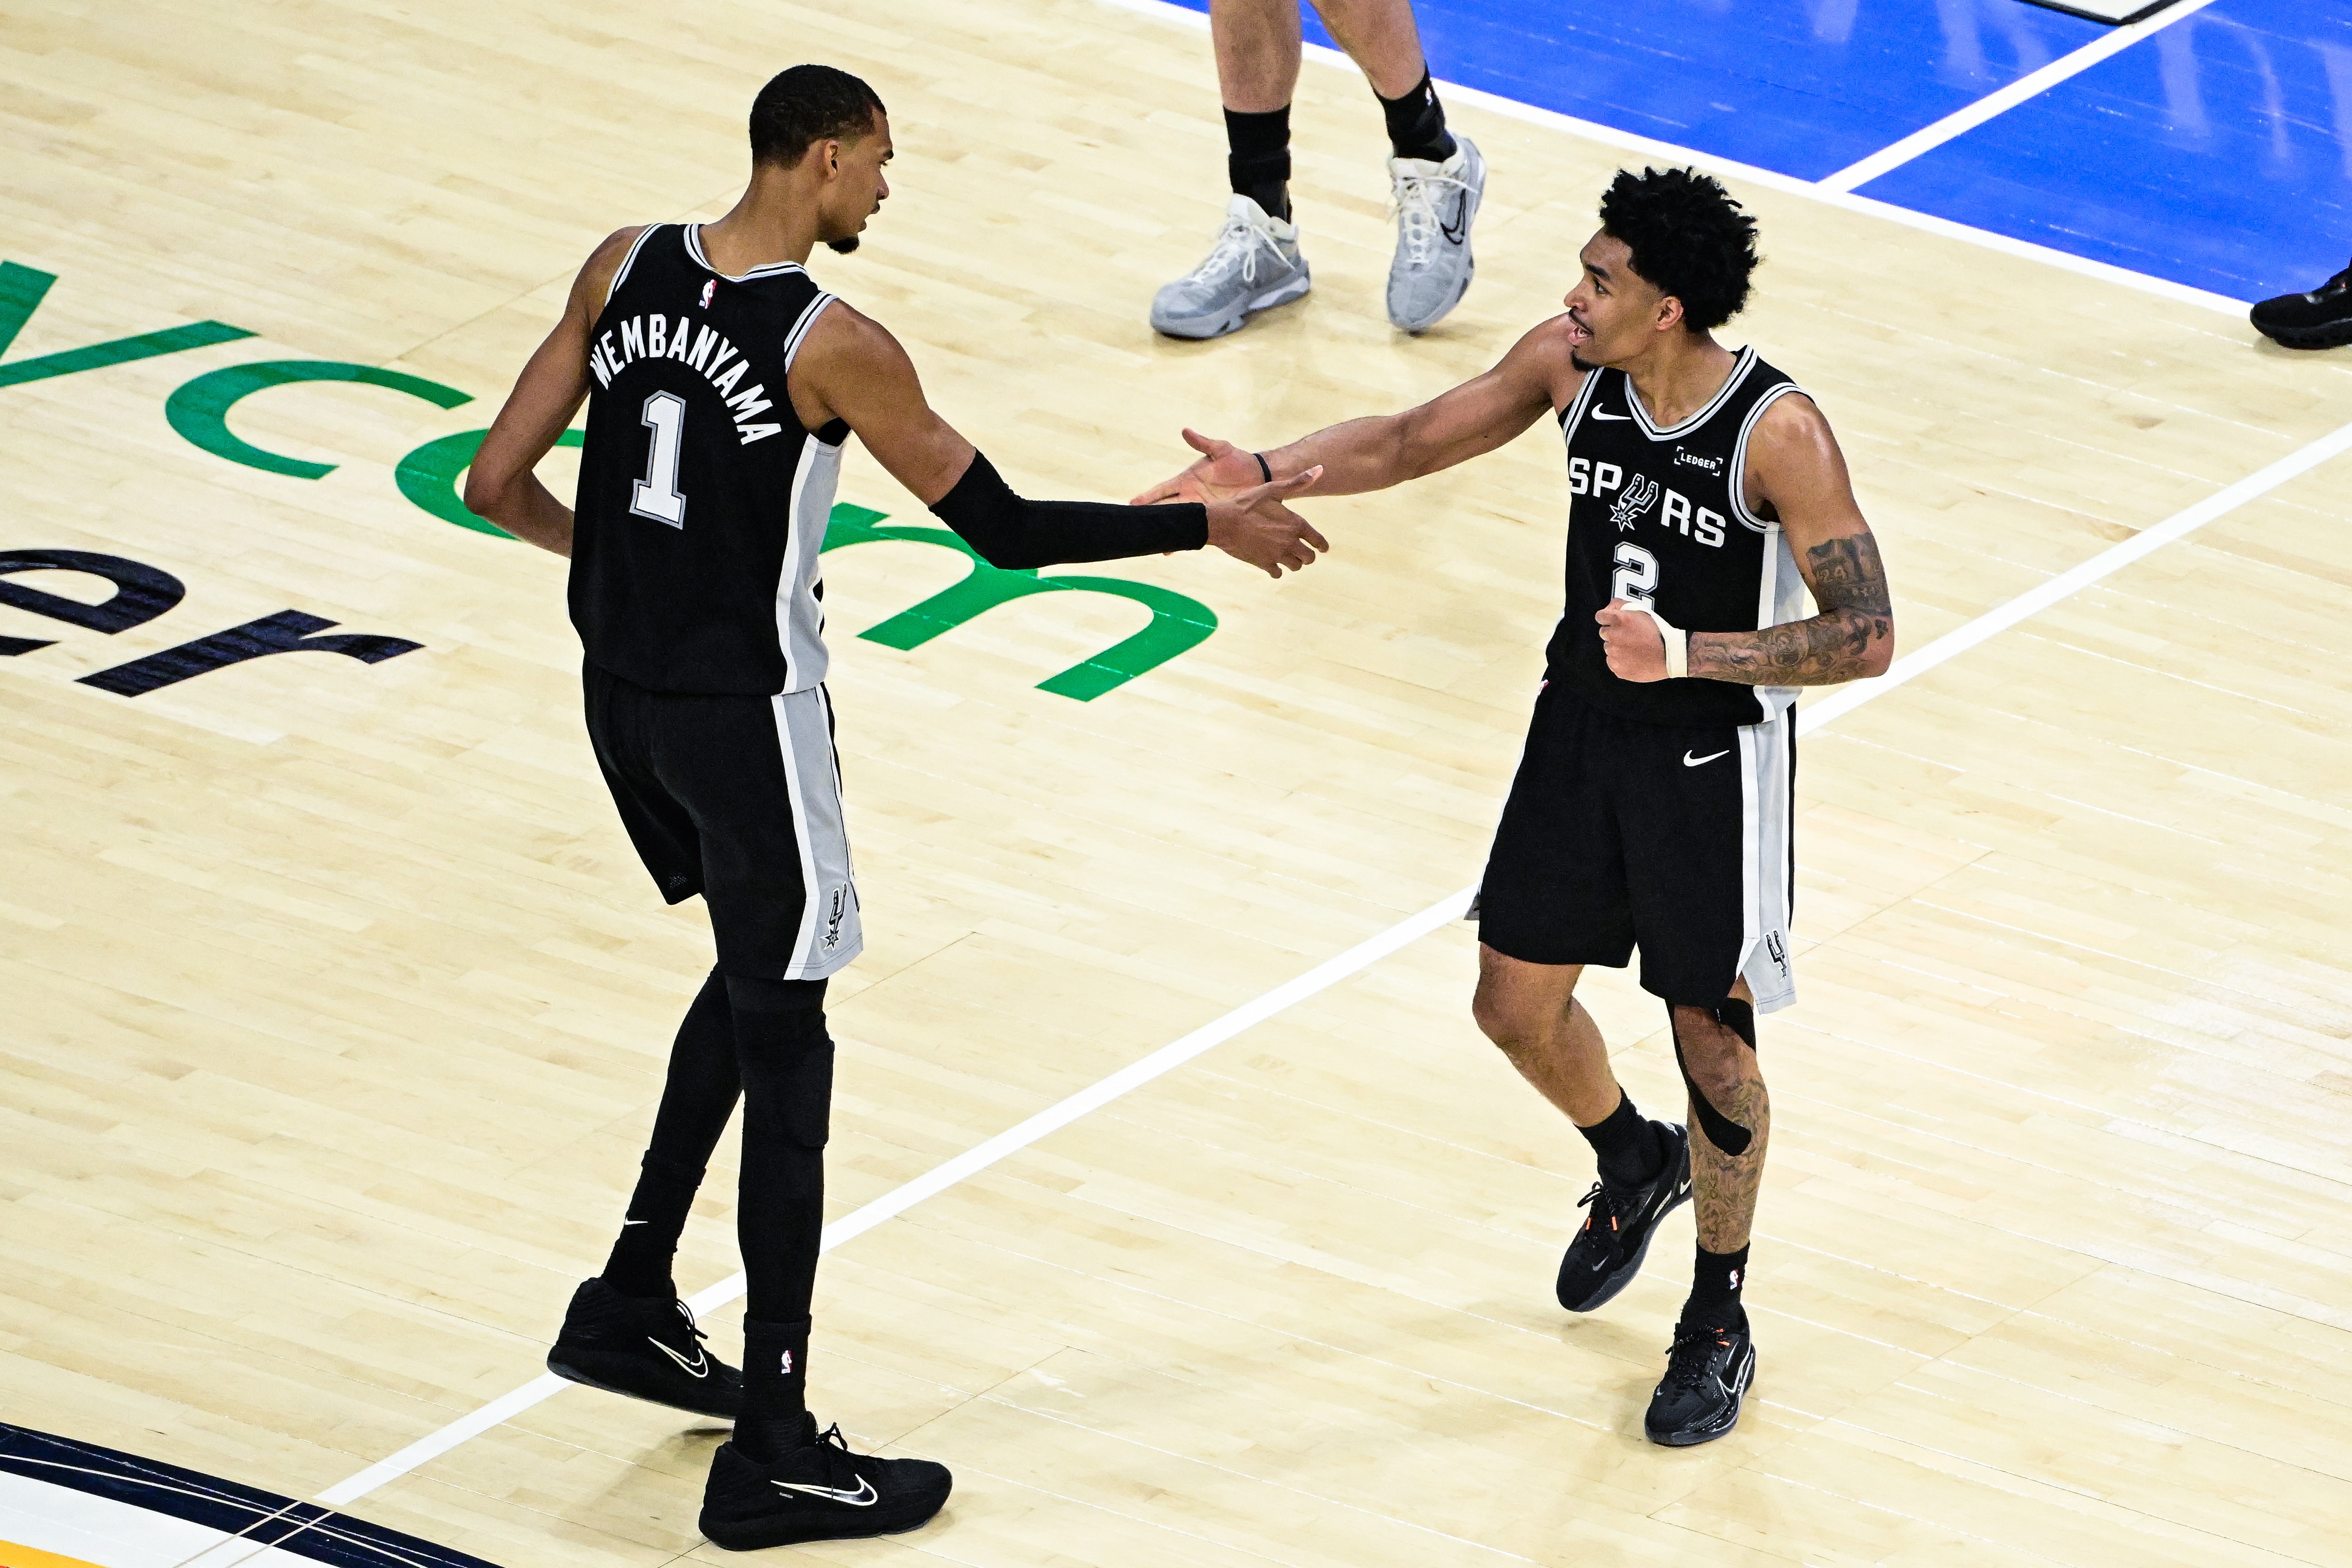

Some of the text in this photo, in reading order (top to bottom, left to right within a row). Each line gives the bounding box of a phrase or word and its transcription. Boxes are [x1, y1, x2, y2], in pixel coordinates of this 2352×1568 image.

[590, 313, 782, 445] WEMBANYAMA
[629, 390, 686, 530] 1
[1680, 452, 1716, 470] LEDGER
[1612, 541, 1659, 611] 2
